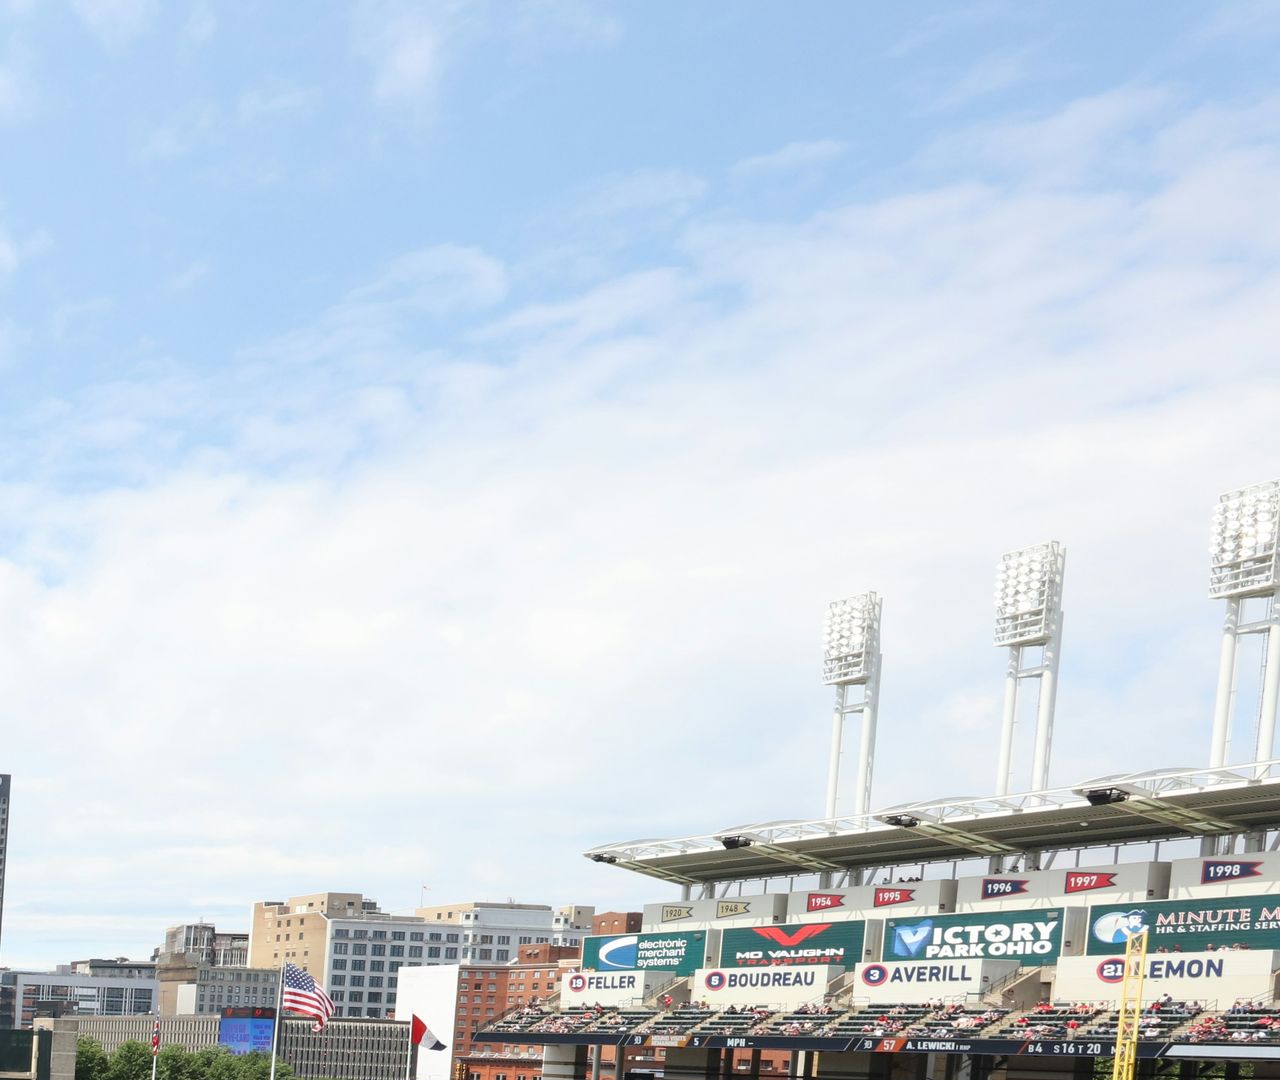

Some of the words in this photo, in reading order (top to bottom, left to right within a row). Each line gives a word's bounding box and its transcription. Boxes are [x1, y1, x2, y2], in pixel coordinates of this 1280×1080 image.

[1208, 865, 1240, 878] 1998
[1069, 875, 1097, 888] 1997
[987, 883, 1011, 894] 1996
[811, 897, 832, 907] 1954
[878, 891, 901, 902] 1995
[665, 908, 682, 918] 1920
[720, 903, 739, 914] 1948
[1155, 908, 1251, 926] MINUTE
[1156, 926, 1174, 934] HR
[1189, 922, 1250, 933] STAFFING
[638, 939, 687, 949] electronic
[926, 943, 984, 958] PARK
[988, 940, 1052, 956] OHIO
[637, 948, 686, 958] merchant
[736, 951, 764, 960] MO
[769, 948, 844, 959] VAUGHN
[890, 965, 972, 983] AVERILL
[1103, 964, 1124, 976] 21
[571, 978, 583, 988] 19
[587, 976, 636, 990] FELLER
[728, 971, 815, 988] BOUDREAU
[727, 1038, 746, 1047] MPH
[883, 1040, 896, 1050] 57
[906, 1041, 915, 1050] A.
[917, 1041, 955, 1050] LEWICKI
